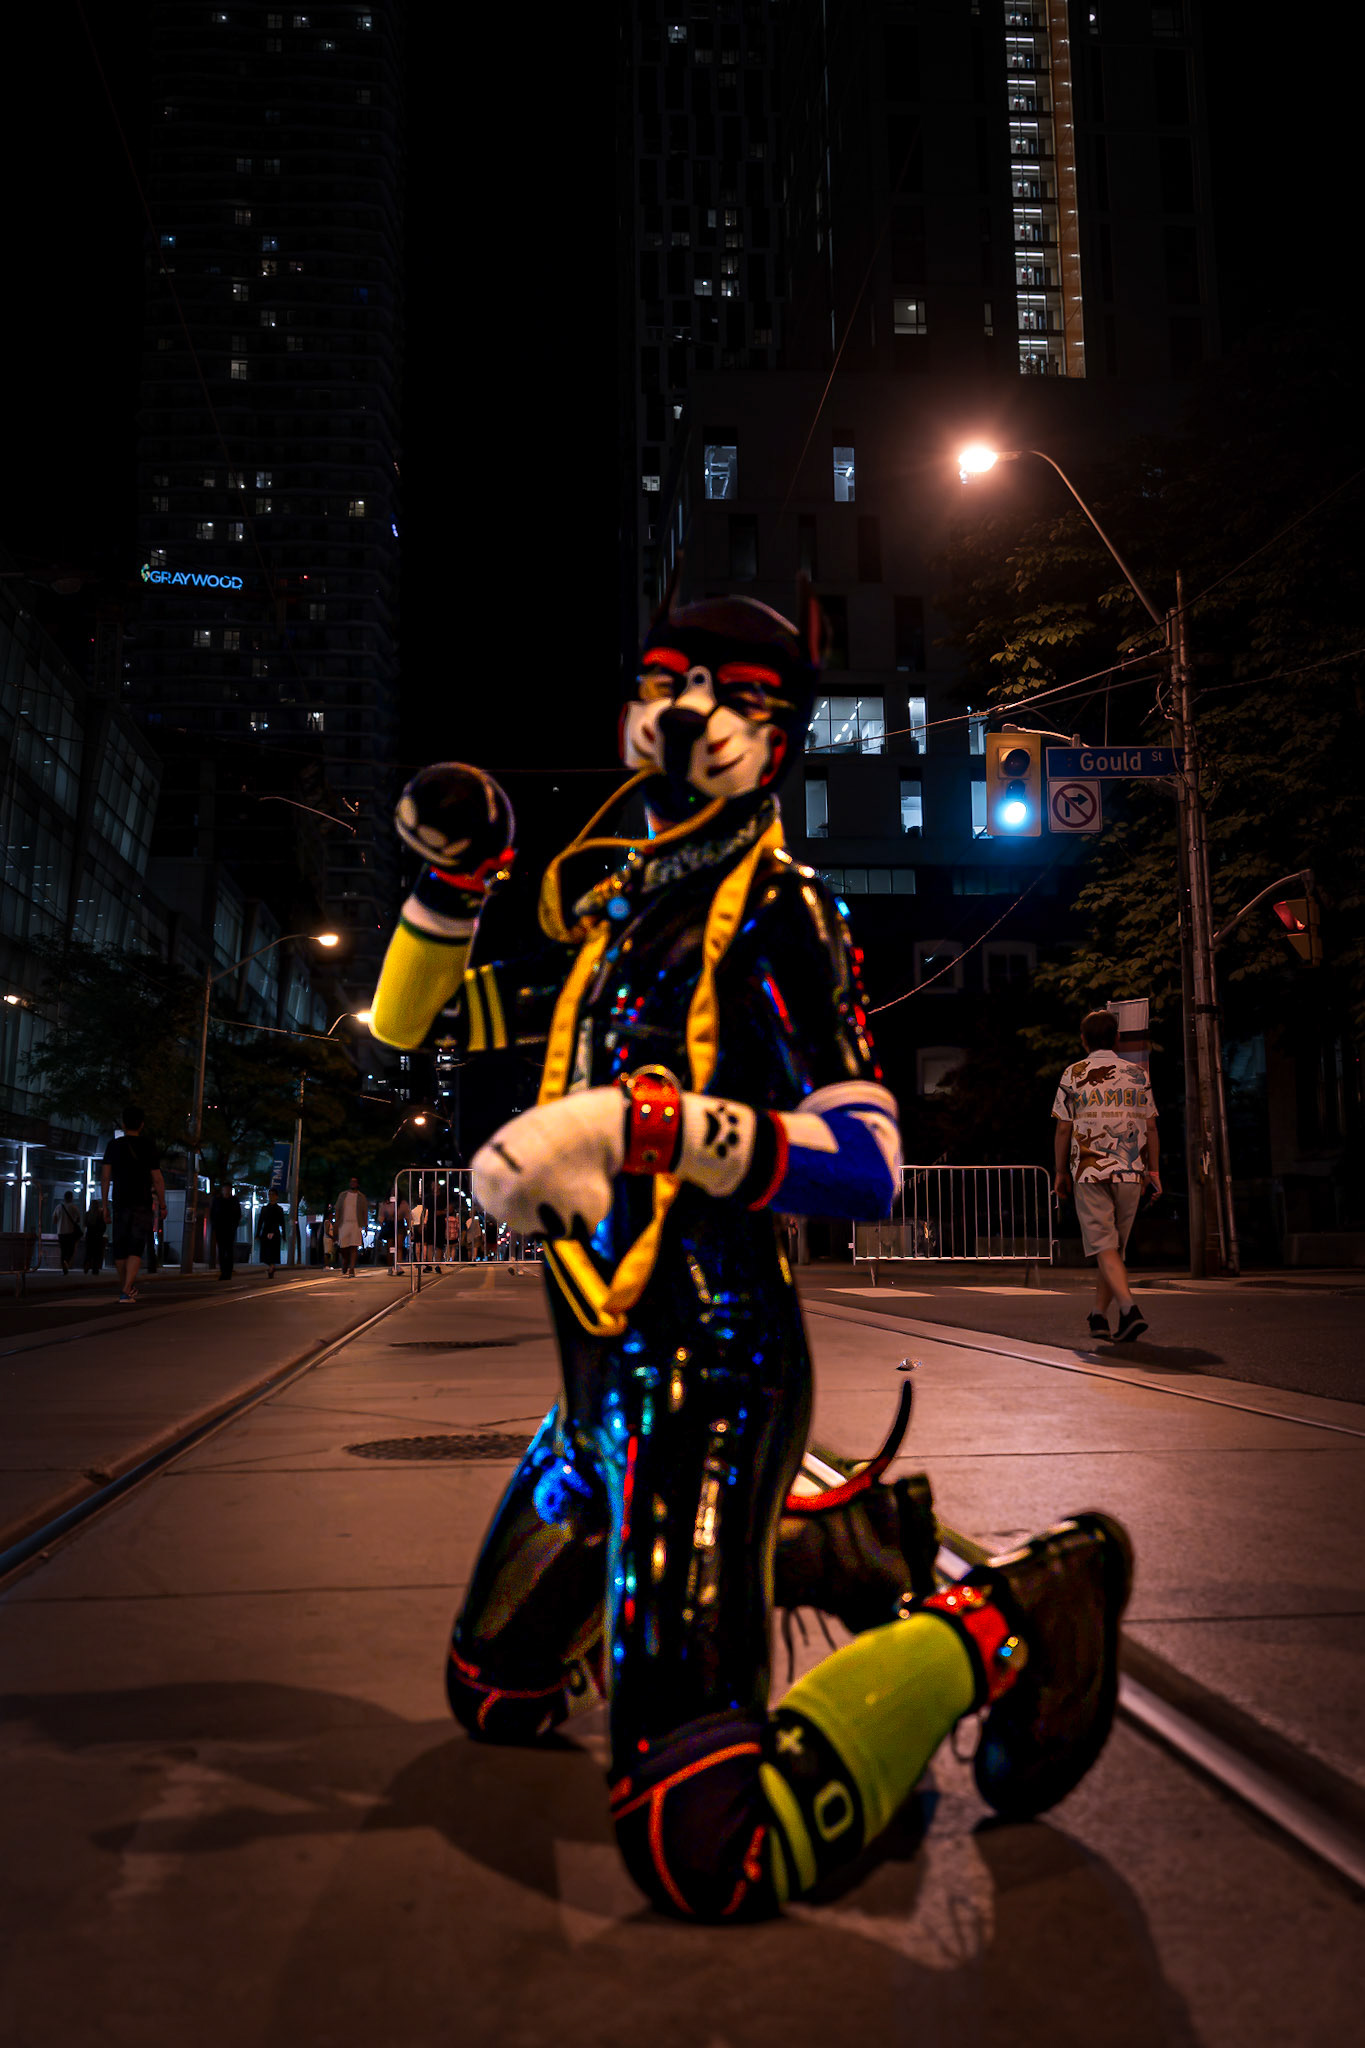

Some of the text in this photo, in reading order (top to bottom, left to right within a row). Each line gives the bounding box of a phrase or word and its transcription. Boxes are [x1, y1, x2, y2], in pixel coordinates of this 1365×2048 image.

[149, 570, 243, 589] GRAYWOOD
[1080, 751, 1163, 772] Gould St
[271, 1159, 284, 1188] TMU
